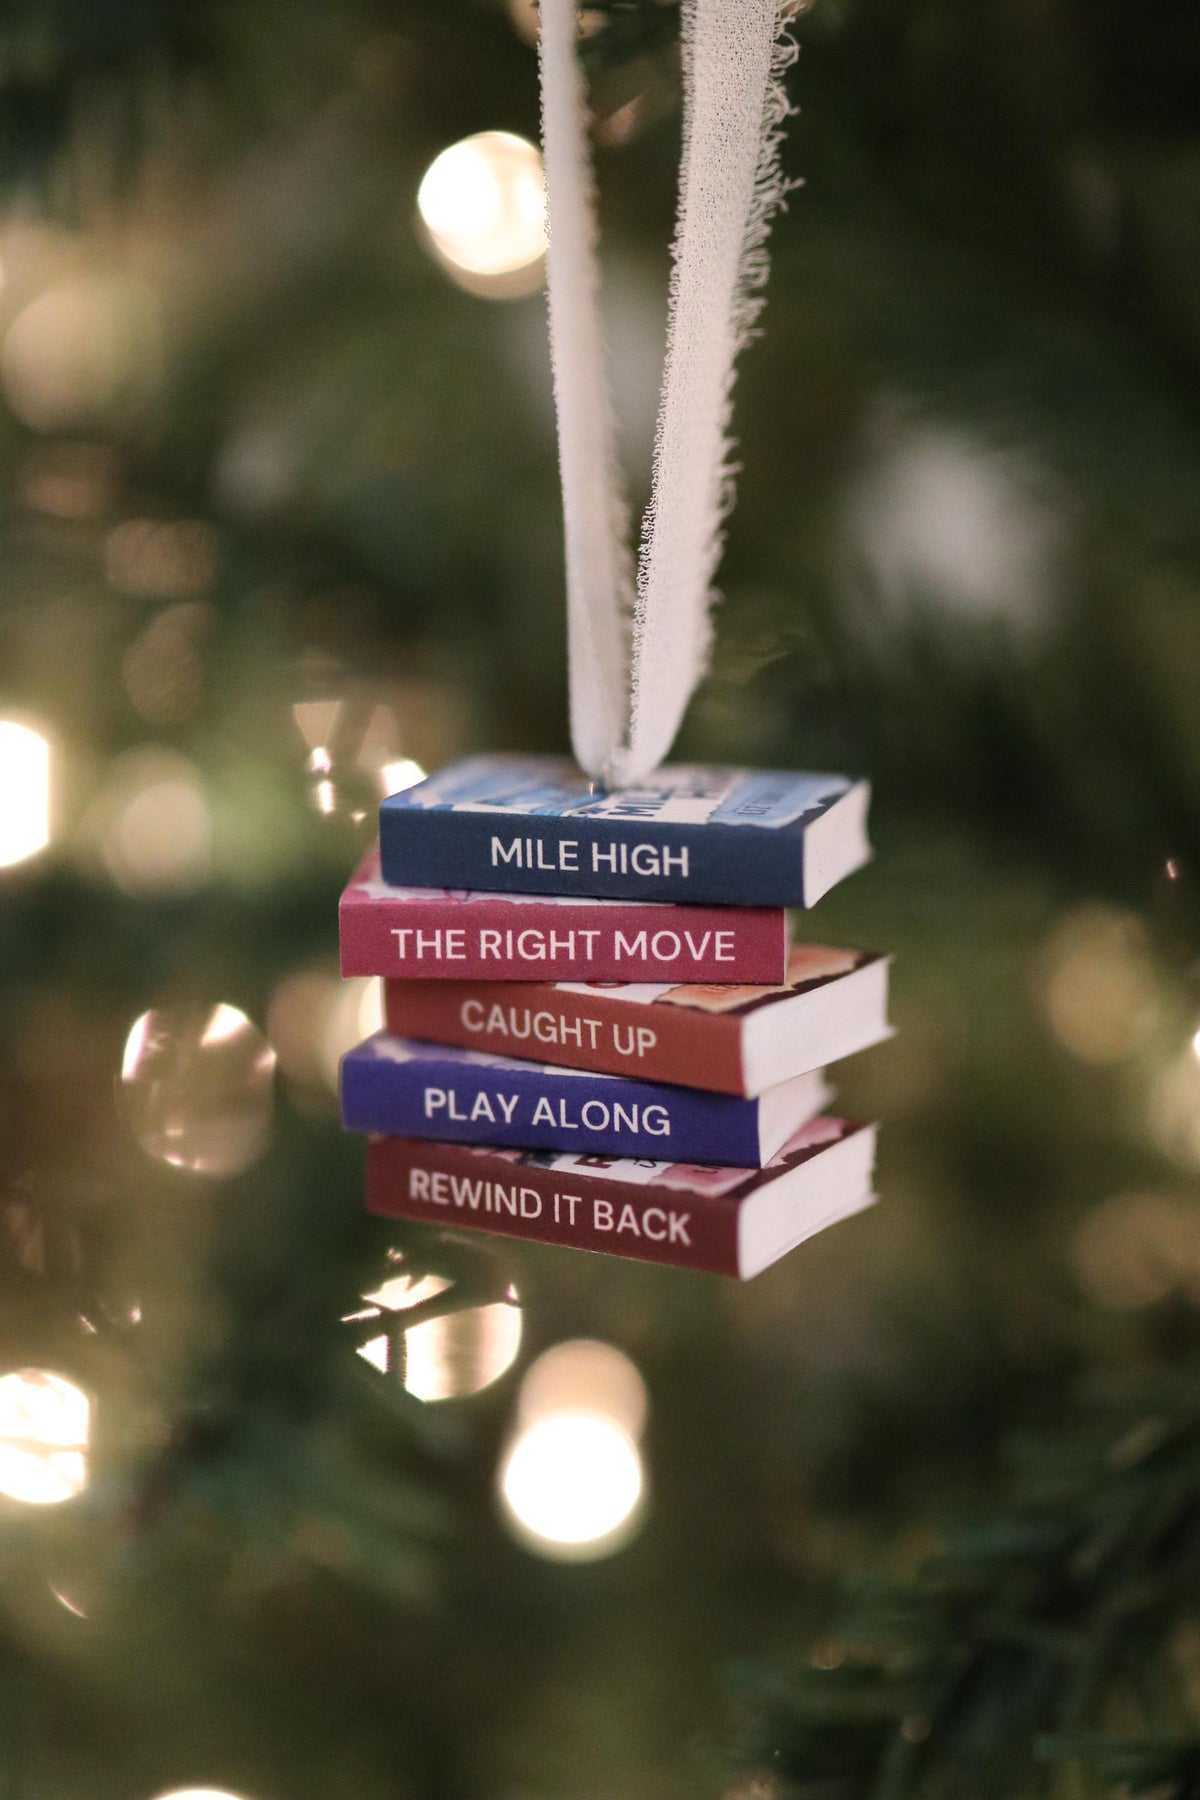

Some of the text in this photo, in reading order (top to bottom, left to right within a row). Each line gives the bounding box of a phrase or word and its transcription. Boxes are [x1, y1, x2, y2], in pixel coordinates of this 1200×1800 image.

[491, 836, 689, 878] MILE HIGH
[390, 928, 736, 962] THE RIGHT MOVE
[460, 1000, 657, 1058] CAUGHT UP
[424, 1087, 671, 1136] PLAY ALONG
[409, 1167, 692, 1247] REWIND IT BACK
